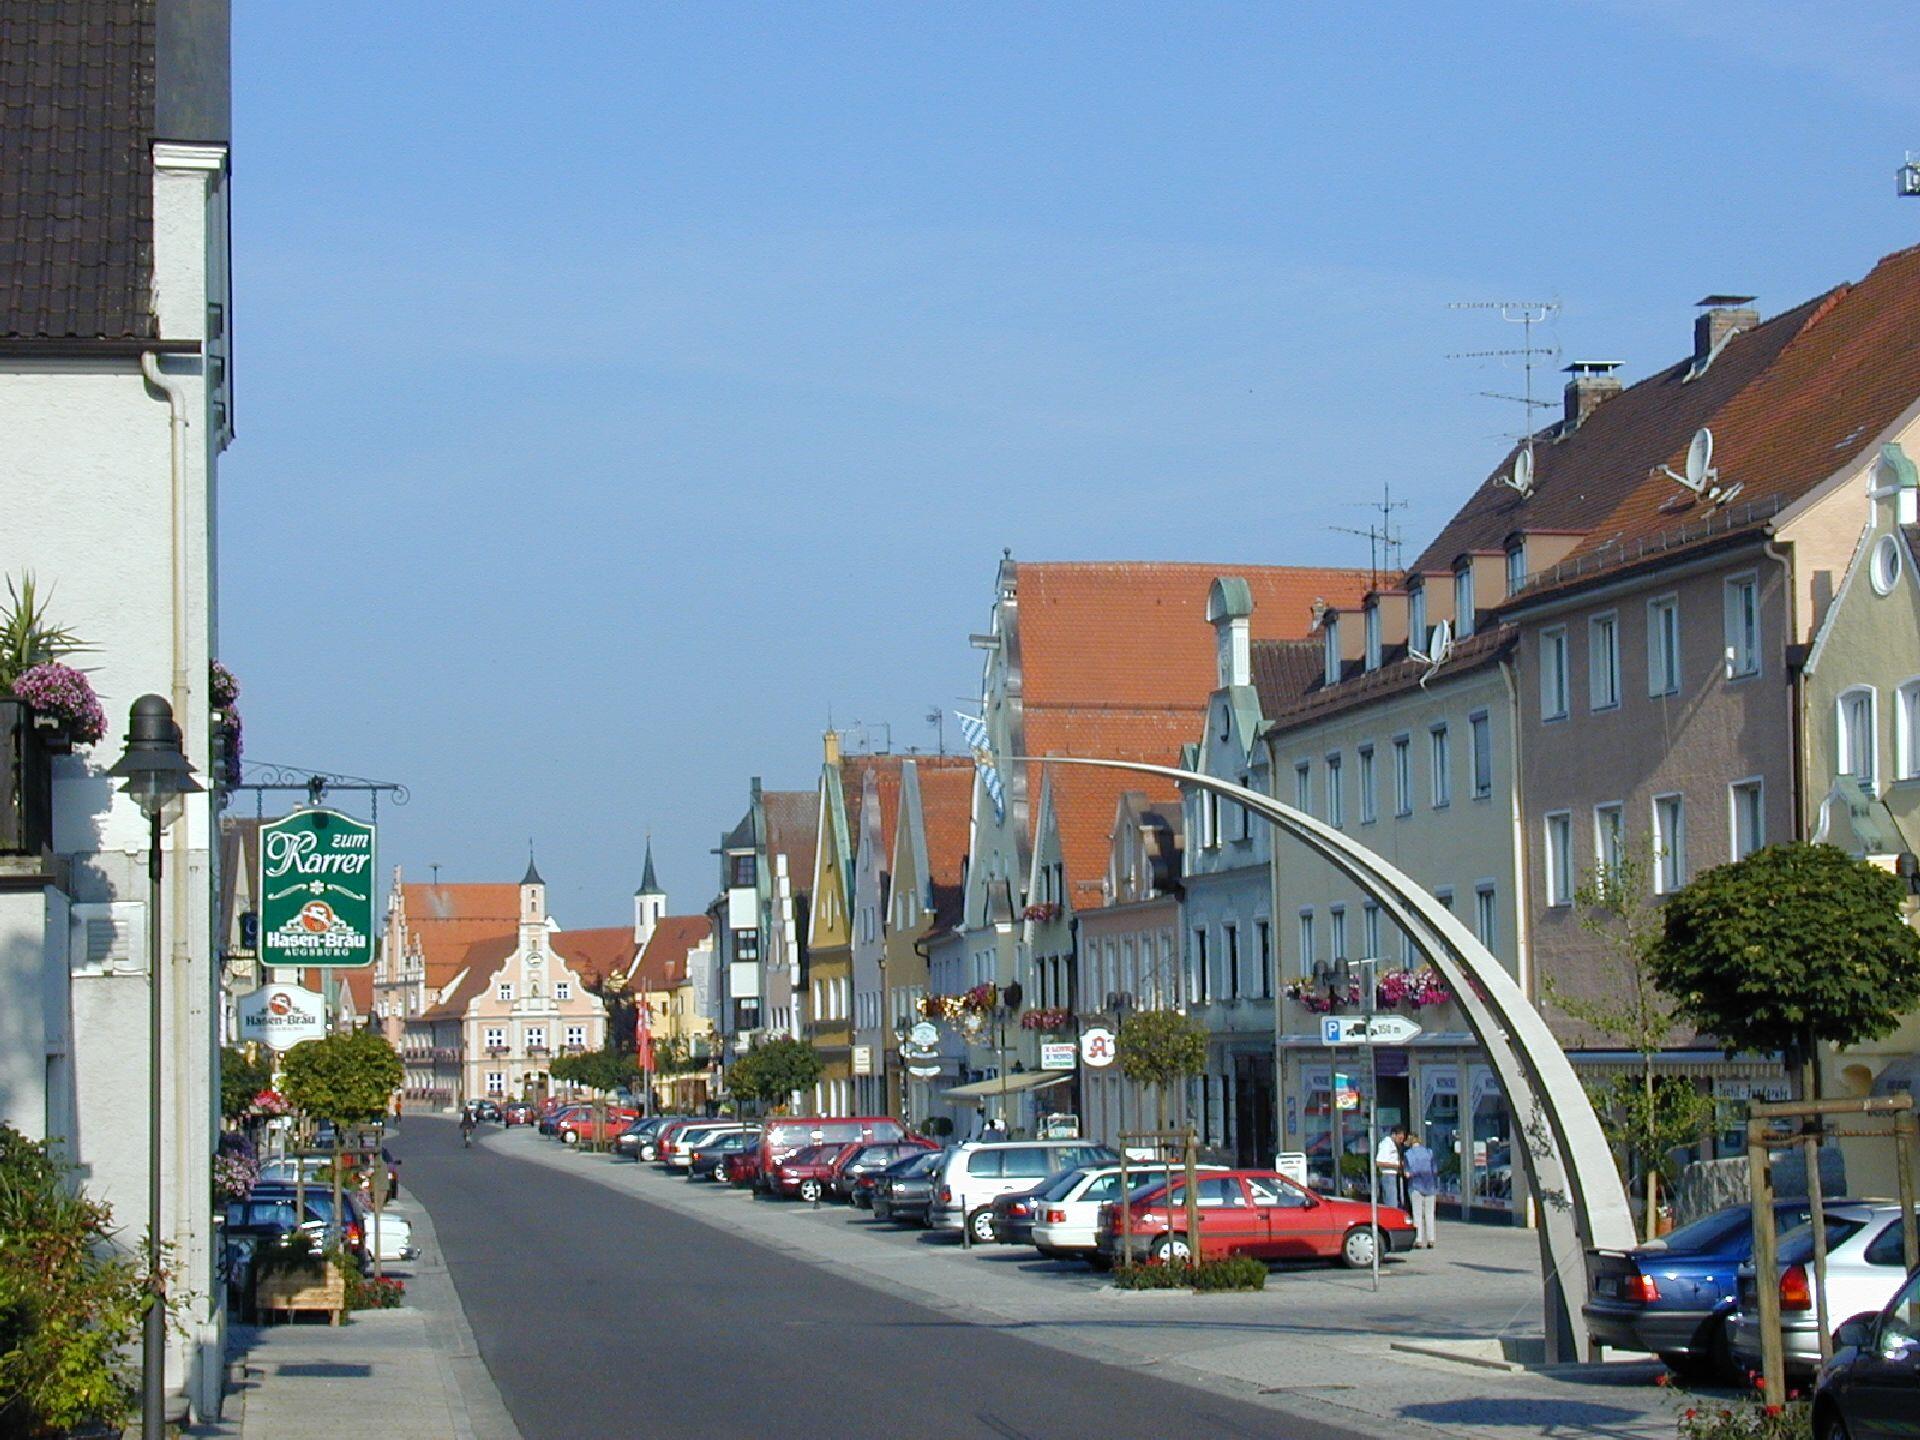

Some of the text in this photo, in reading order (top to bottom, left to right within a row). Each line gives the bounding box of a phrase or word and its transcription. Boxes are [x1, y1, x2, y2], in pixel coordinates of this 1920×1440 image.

[332, 834, 369, 848] zum
[266, 831, 370, 877] Karrer
[267, 931, 366, 948] Hasen-Bräu
[284, 948, 350, 957] AUGSBURG
[245, 1015, 316, 1026] Hasen-Bräu
[1328, 1022, 1338, 1039] P
